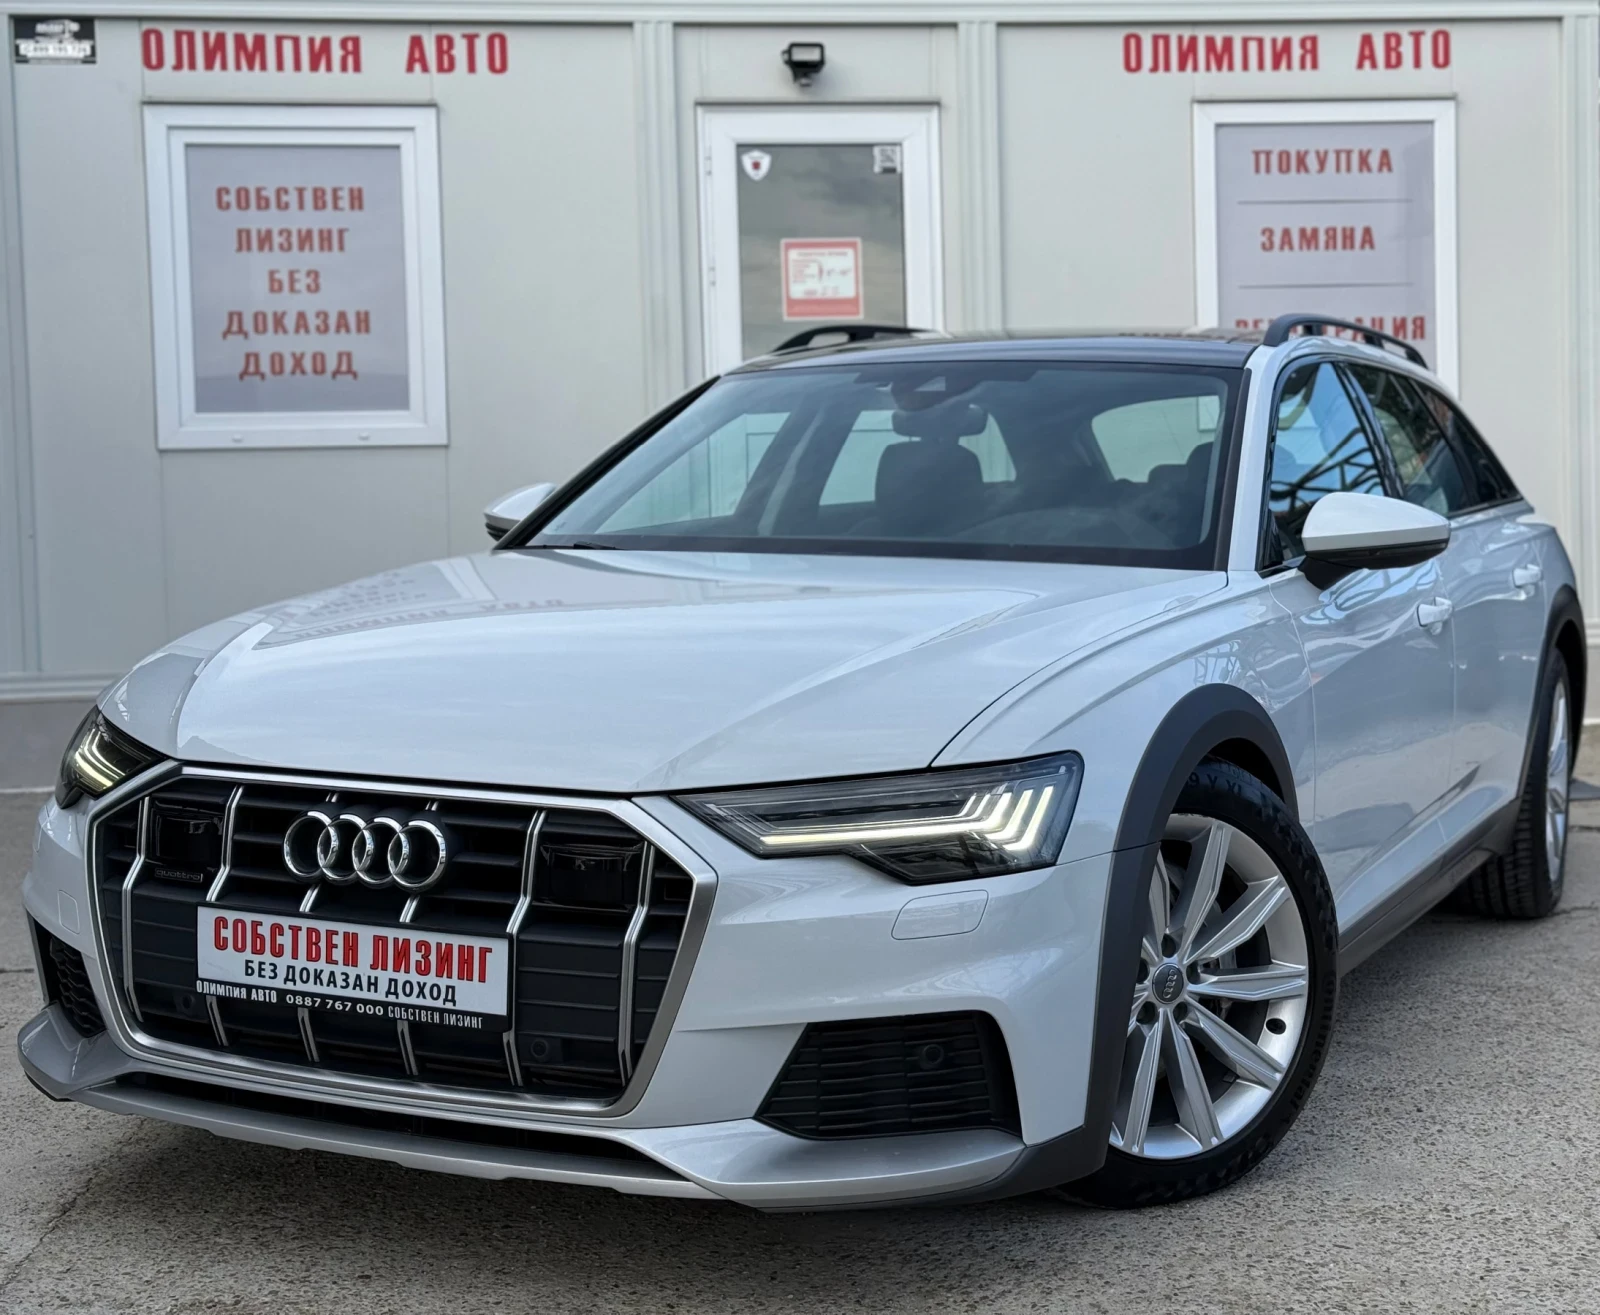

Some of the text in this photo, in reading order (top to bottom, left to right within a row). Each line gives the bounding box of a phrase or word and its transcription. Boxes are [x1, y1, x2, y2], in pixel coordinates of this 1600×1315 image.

[142, 28, 509, 75] ОЛИМПИЯ АВТО
[1122, 29, 1451, 73] ОЛИМПИЯ АВТО
[1252, 148, 1393, 175] ПОКУПКА
[216, 186, 364, 211] СОБСТВЕН
[235, 228, 350, 253] ЛИЗИНГ
[1261, 226, 1375, 252] ЗАМЯНА
[268, 269, 321, 294] БЕЗ
[222, 310, 371, 340] ДОКАЗАН
[239, 351, 359, 381] ДОХОД
[155, 869, 201, 881] quattro
[214, 916, 492, 983] СОБСТВЕН ЛИЗИНГ
[244, 959, 457, 1007] БЕЗ ДОКАЗАН ДОХОД
[196, 980, 483, 1029] ОЛИМПИЯ АВТО 0887 767 000 СОБСТВЕН ЛИЗИНГ
